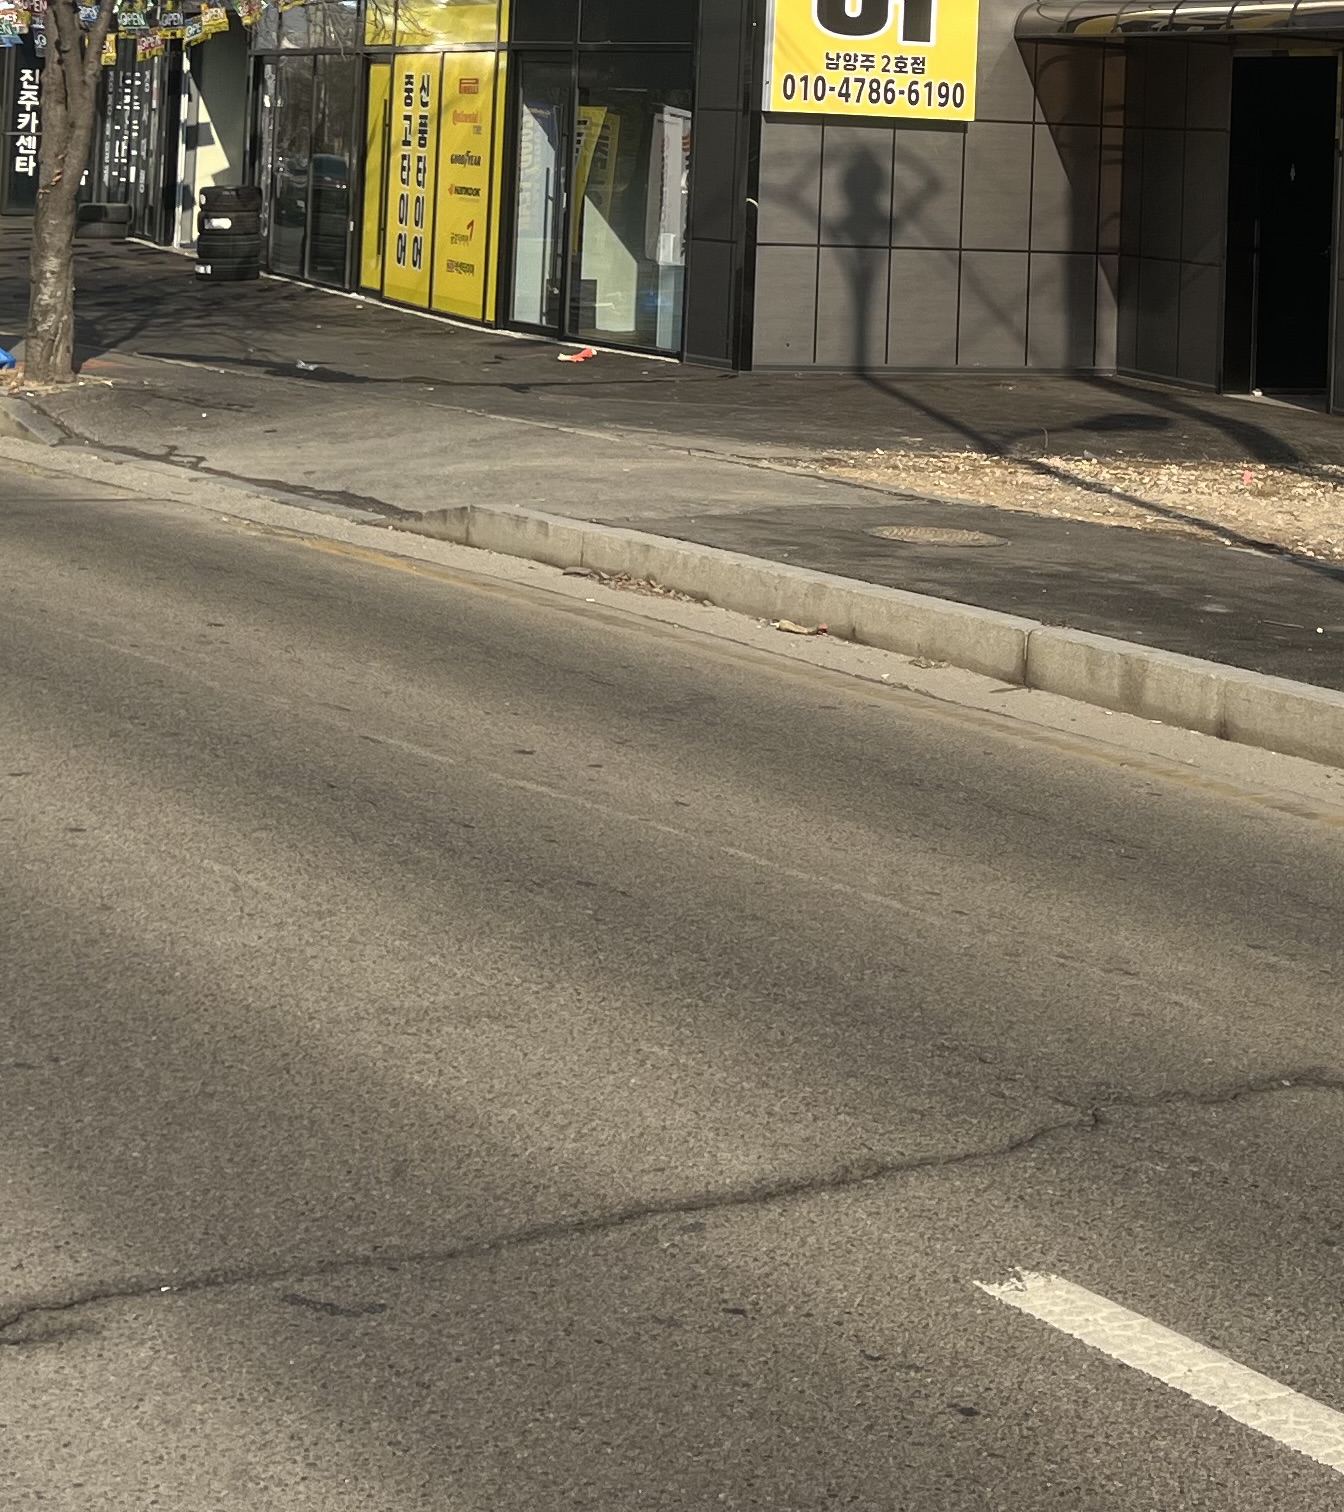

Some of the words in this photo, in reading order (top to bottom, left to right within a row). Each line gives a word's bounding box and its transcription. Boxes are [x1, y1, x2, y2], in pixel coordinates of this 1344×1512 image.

[782, 73, 965, 109] 010-4786-6190
[825, 52, 876, 72] 남양주
[881, 54, 926, 75] 2호점
[14, 68, 41, 177] 진주카센타
[396, 74, 414, 267] 중고타이어
[412, 74, 431, 270] 신품타이어
